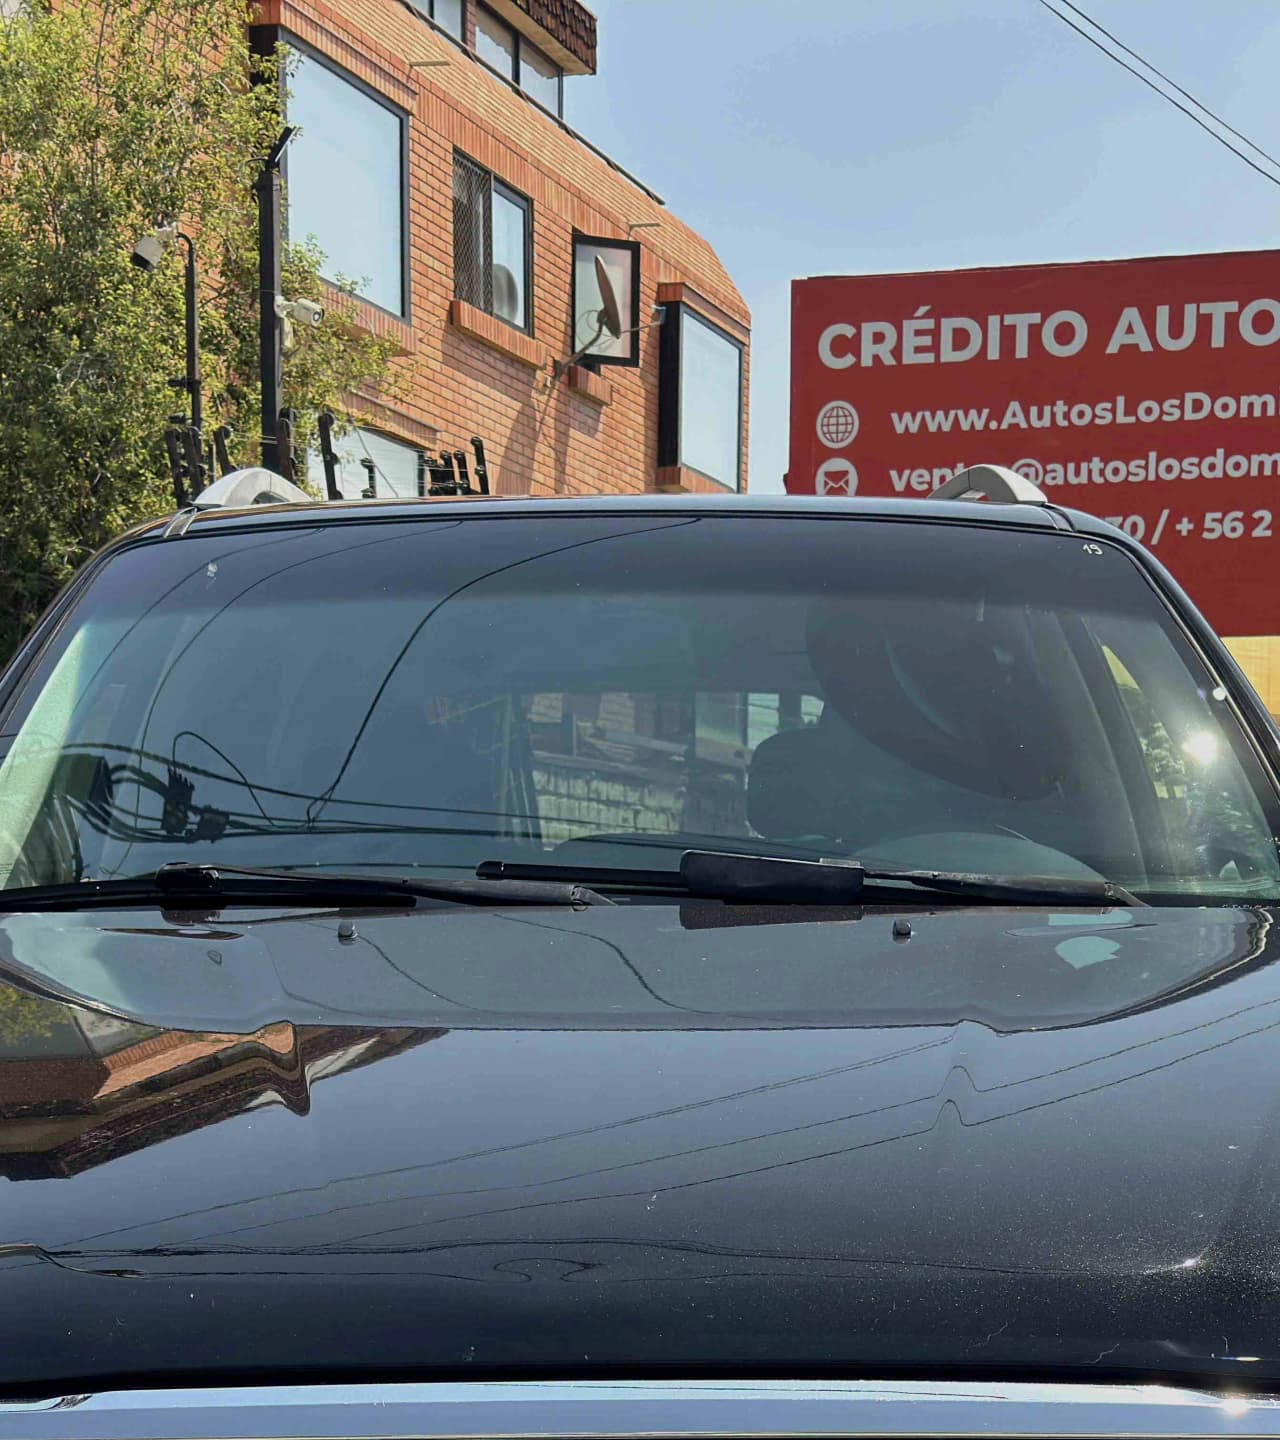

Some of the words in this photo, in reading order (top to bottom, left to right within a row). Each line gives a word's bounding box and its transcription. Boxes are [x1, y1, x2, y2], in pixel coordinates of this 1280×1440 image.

[817, 304, 1088, 370] CRÉDITO
[1202, 510, 1246, 540] 56
[1251, 509, 1274, 538] 2
